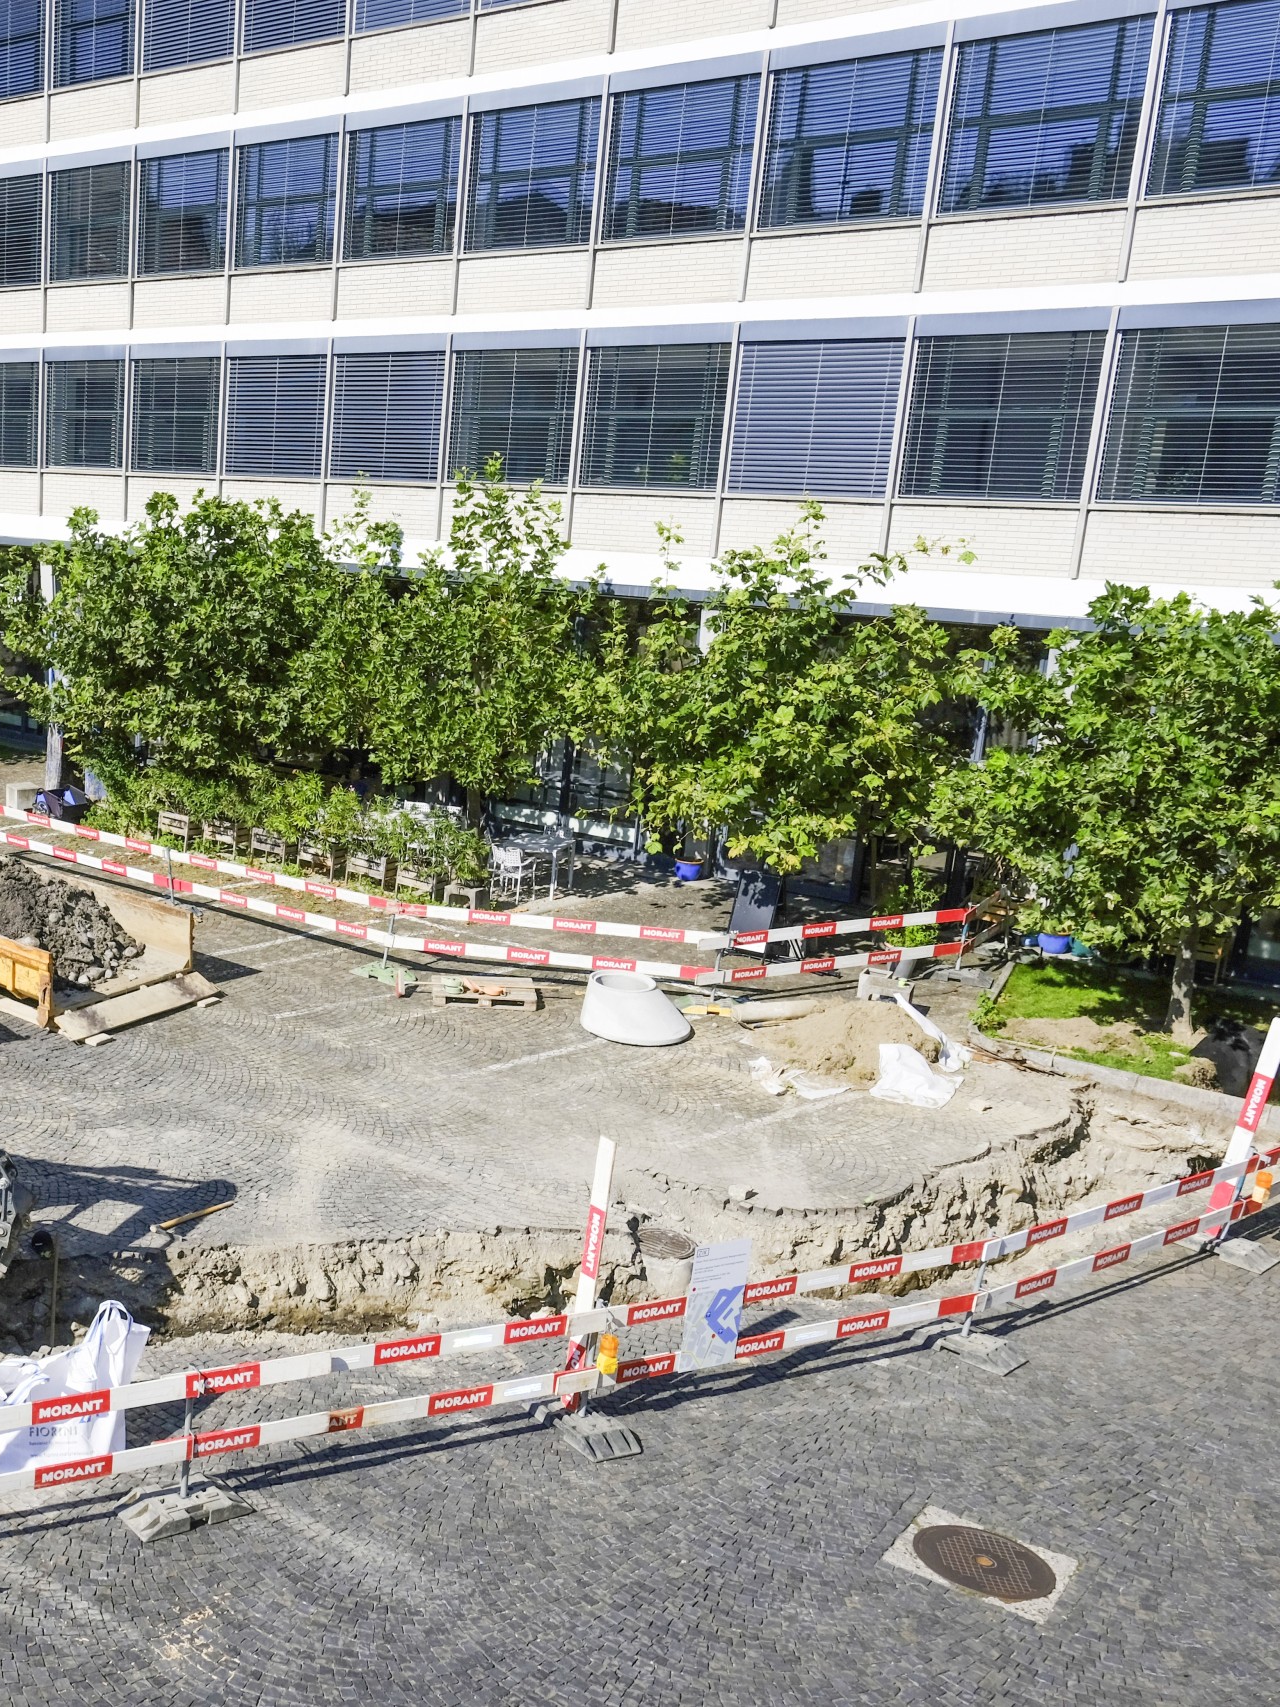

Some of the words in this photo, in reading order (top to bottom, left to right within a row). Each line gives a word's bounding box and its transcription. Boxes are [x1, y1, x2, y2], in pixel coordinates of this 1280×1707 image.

[28, 814, 49, 826] MORANT
[76, 826, 98, 838] MORANT
[7, 835, 28, 847] MORANT
[126, 839, 150, 852] MORANT
[54, 848, 76, 860] MORANT
[103, 862, 125, 874] MORANT
[191, 856, 216, 868] MORANT
[247, 870, 273, 881] MORANT
[307, 883, 335, 895] MORANT
[221, 893, 245, 906] MORANT
[278, 908, 303, 920] MORANT
[472, 912, 508, 922] MORANT
[556, 920, 593, 930] MORANT
[872, 918, 901, 928] MORANT
[338, 924, 365, 936] MORANT
[643, 928, 681, 939] MORANT
[805, 925, 834, 935] MORANT
[737, 934, 766, 943] MORANT
[427, 942, 462, 952] MORANT
[510, 951, 547, 962] MORANT
[871, 952, 899, 961] MORANT
[595, 959, 633, 970] MORANT
[803, 961, 832, 970] MORANT
[734, 969, 764, 978] MORANT
[1244, 1079, 1266, 1126] MORANT
[1181, 1176, 1210, 1191] MORANT
[1108, 1200, 1139, 1216] MORANT
[1031, 1225, 1063, 1242] MORANT
[1168, 1224, 1196, 1240] MORANT
[585, 1212, 601, 1271] MORANT
[1097, 1250, 1127, 1266] MORANT
[854, 1262, 898, 1278] MORANT
[746, 1282, 792, 1298] MORANT
[1020, 1276, 1053, 1293] MORANT
[633, 1303, 682, 1320] MORANT
[509, 1321, 561, 1338] MORANT
[841, 1316, 885, 1333] MORANT
[380, 1341, 435, 1359] MORANT
[736, 1338, 780, 1353] MORANT
[622, 1360, 670, 1378] MORANT
[434, 1391, 488, 1410] MORANT
[38, 1399, 103, 1420] MORANT
[194, 1433, 254, 1453] MORANT
[41, 1462, 105, 1483] MORANT
